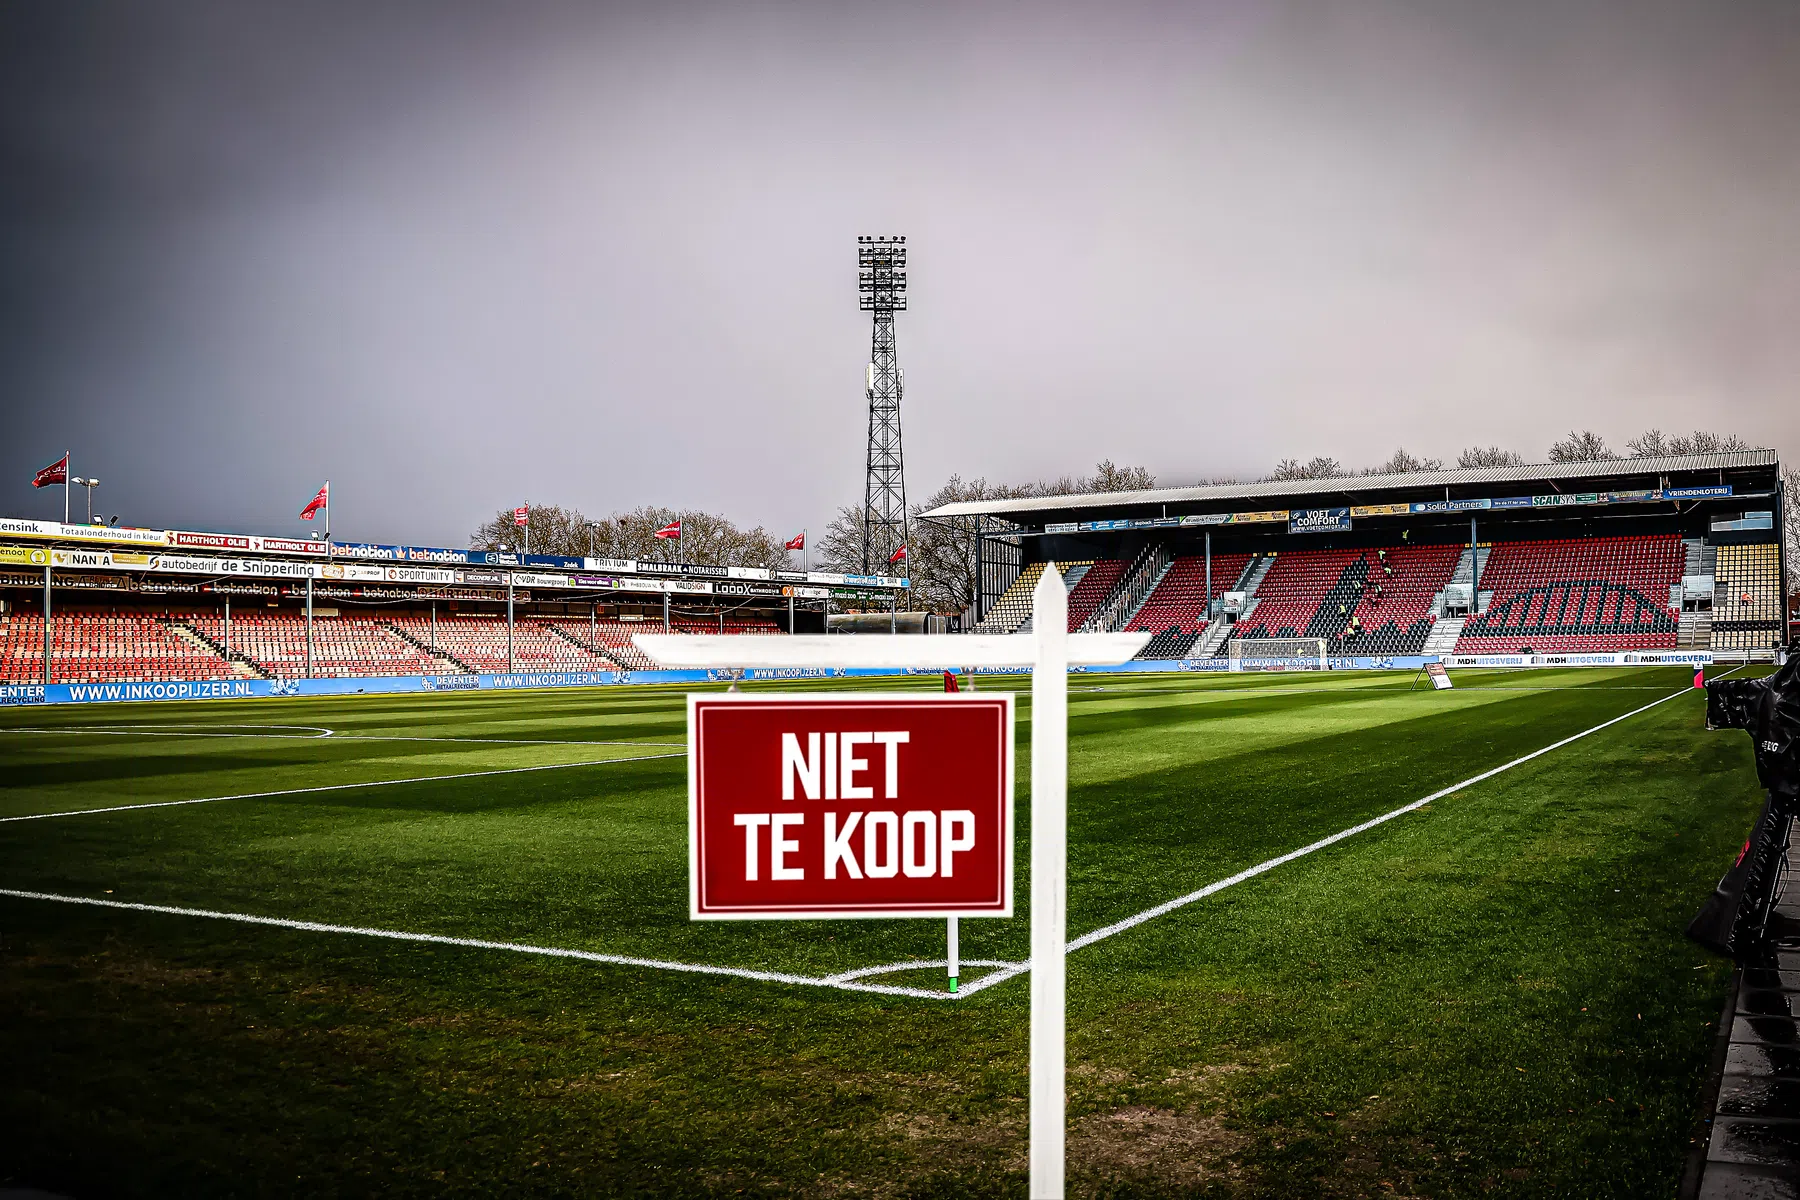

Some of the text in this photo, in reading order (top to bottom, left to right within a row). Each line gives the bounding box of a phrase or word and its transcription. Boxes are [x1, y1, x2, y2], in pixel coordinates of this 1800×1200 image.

[1668, 488, 1727, 497] VRIENDENLOTERIJ
[1449, 501, 1483, 509] Partners
[1306, 510, 1330, 518] VOET
[1297, 517, 1340, 526] COMFORT
[61, 527, 131, 540] Totaalonderhoud
[142, 533, 161, 541] kleur
[179, 535, 247, 547] HARTHOLT OLIE
[264, 541, 325, 552] HARTHOLT OLIE
[330, 542, 392, 559] betnation
[409, 548, 466, 562] betnation
[162, 560, 217, 572] autobedrijf
[222, 561, 238, 571] de
[243, 562, 314, 577] Snipperling
[594, 558, 628, 568] TRIVIUM
[399, 570, 449, 580] SPORTUNITY
[638, 563, 728, 576] SMALBRAAK NOTARISSEN
[0, 574, 74, 586] BRIDGNG
[436, 675, 479, 684] DEVENTER
[493, 673, 602, 687] WWW.INKOOPIJZER.NL
[69, 681, 254, 701] WWW.INKOOPIJZER.NL
[782, 731, 910, 800] NIET
[734, 810, 976, 881] TE KOOP
